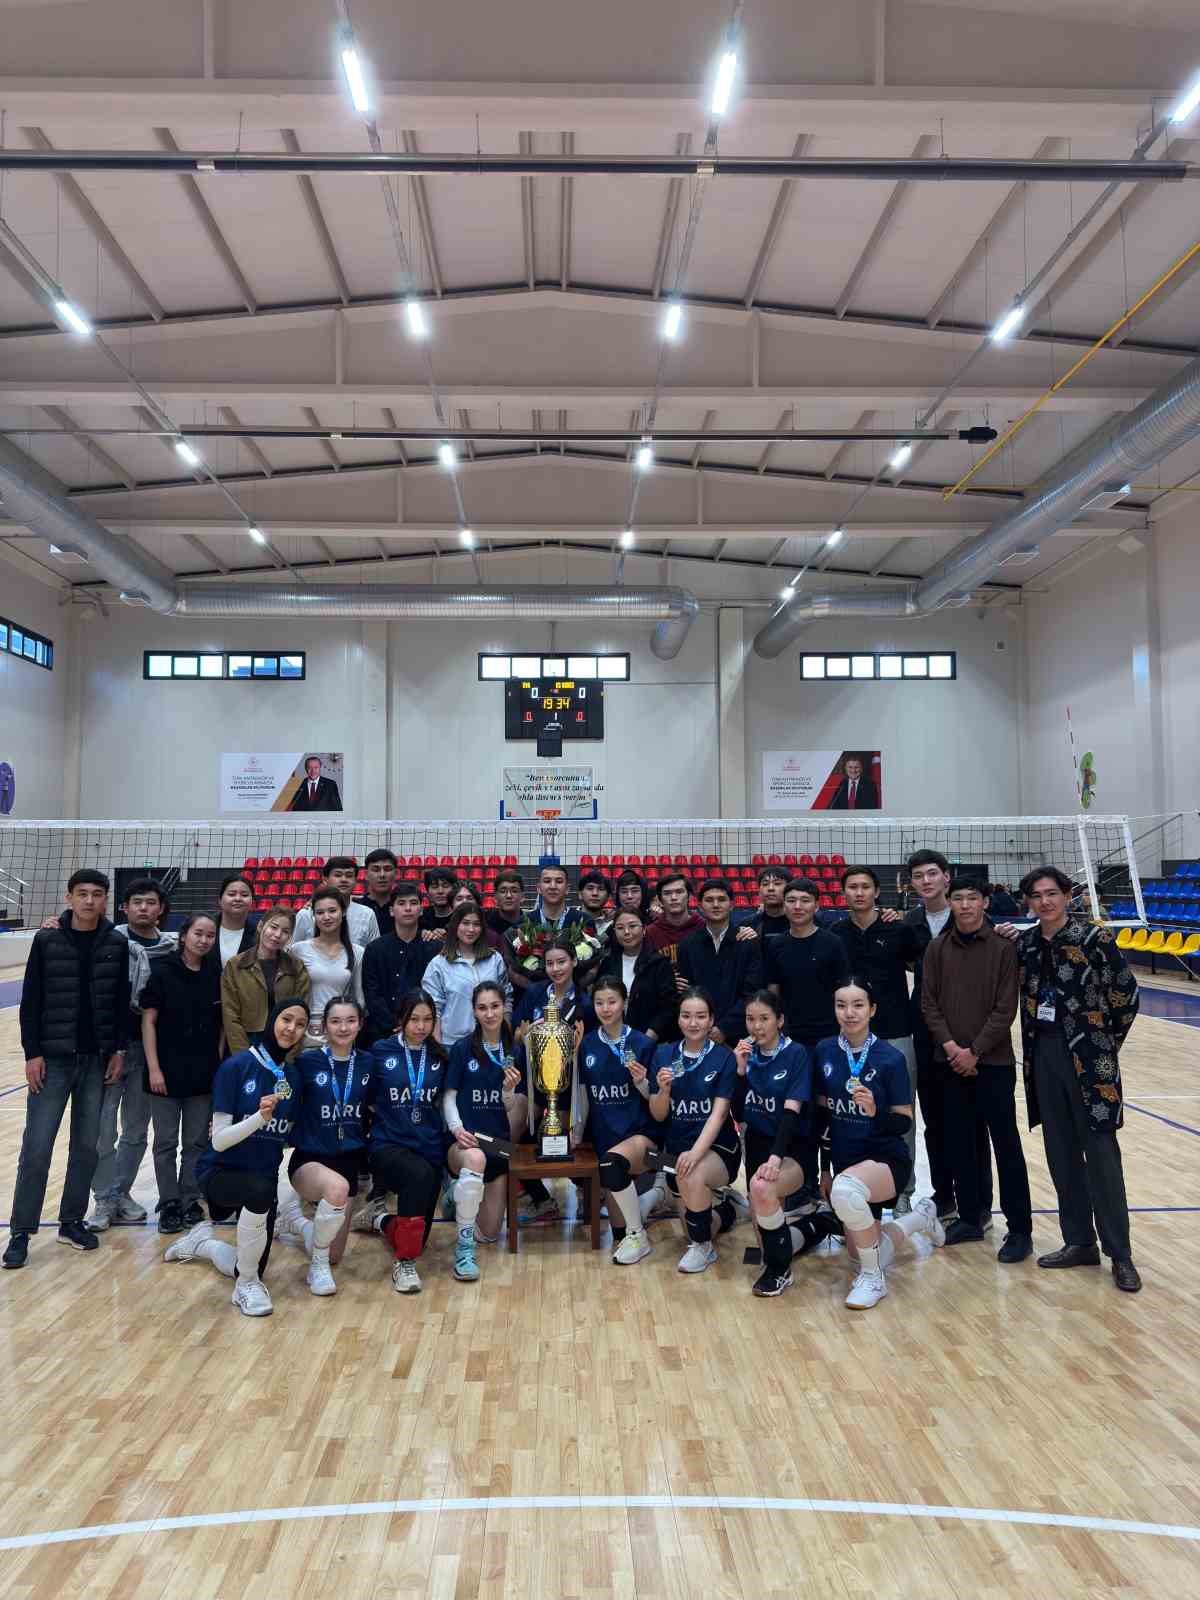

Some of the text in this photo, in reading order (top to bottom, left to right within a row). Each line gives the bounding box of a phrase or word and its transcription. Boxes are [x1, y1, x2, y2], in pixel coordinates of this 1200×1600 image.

[531, 687, 538, 698] 0
[579, 687, 586, 698] 0
[472, 1089, 500, 1105] BAR
